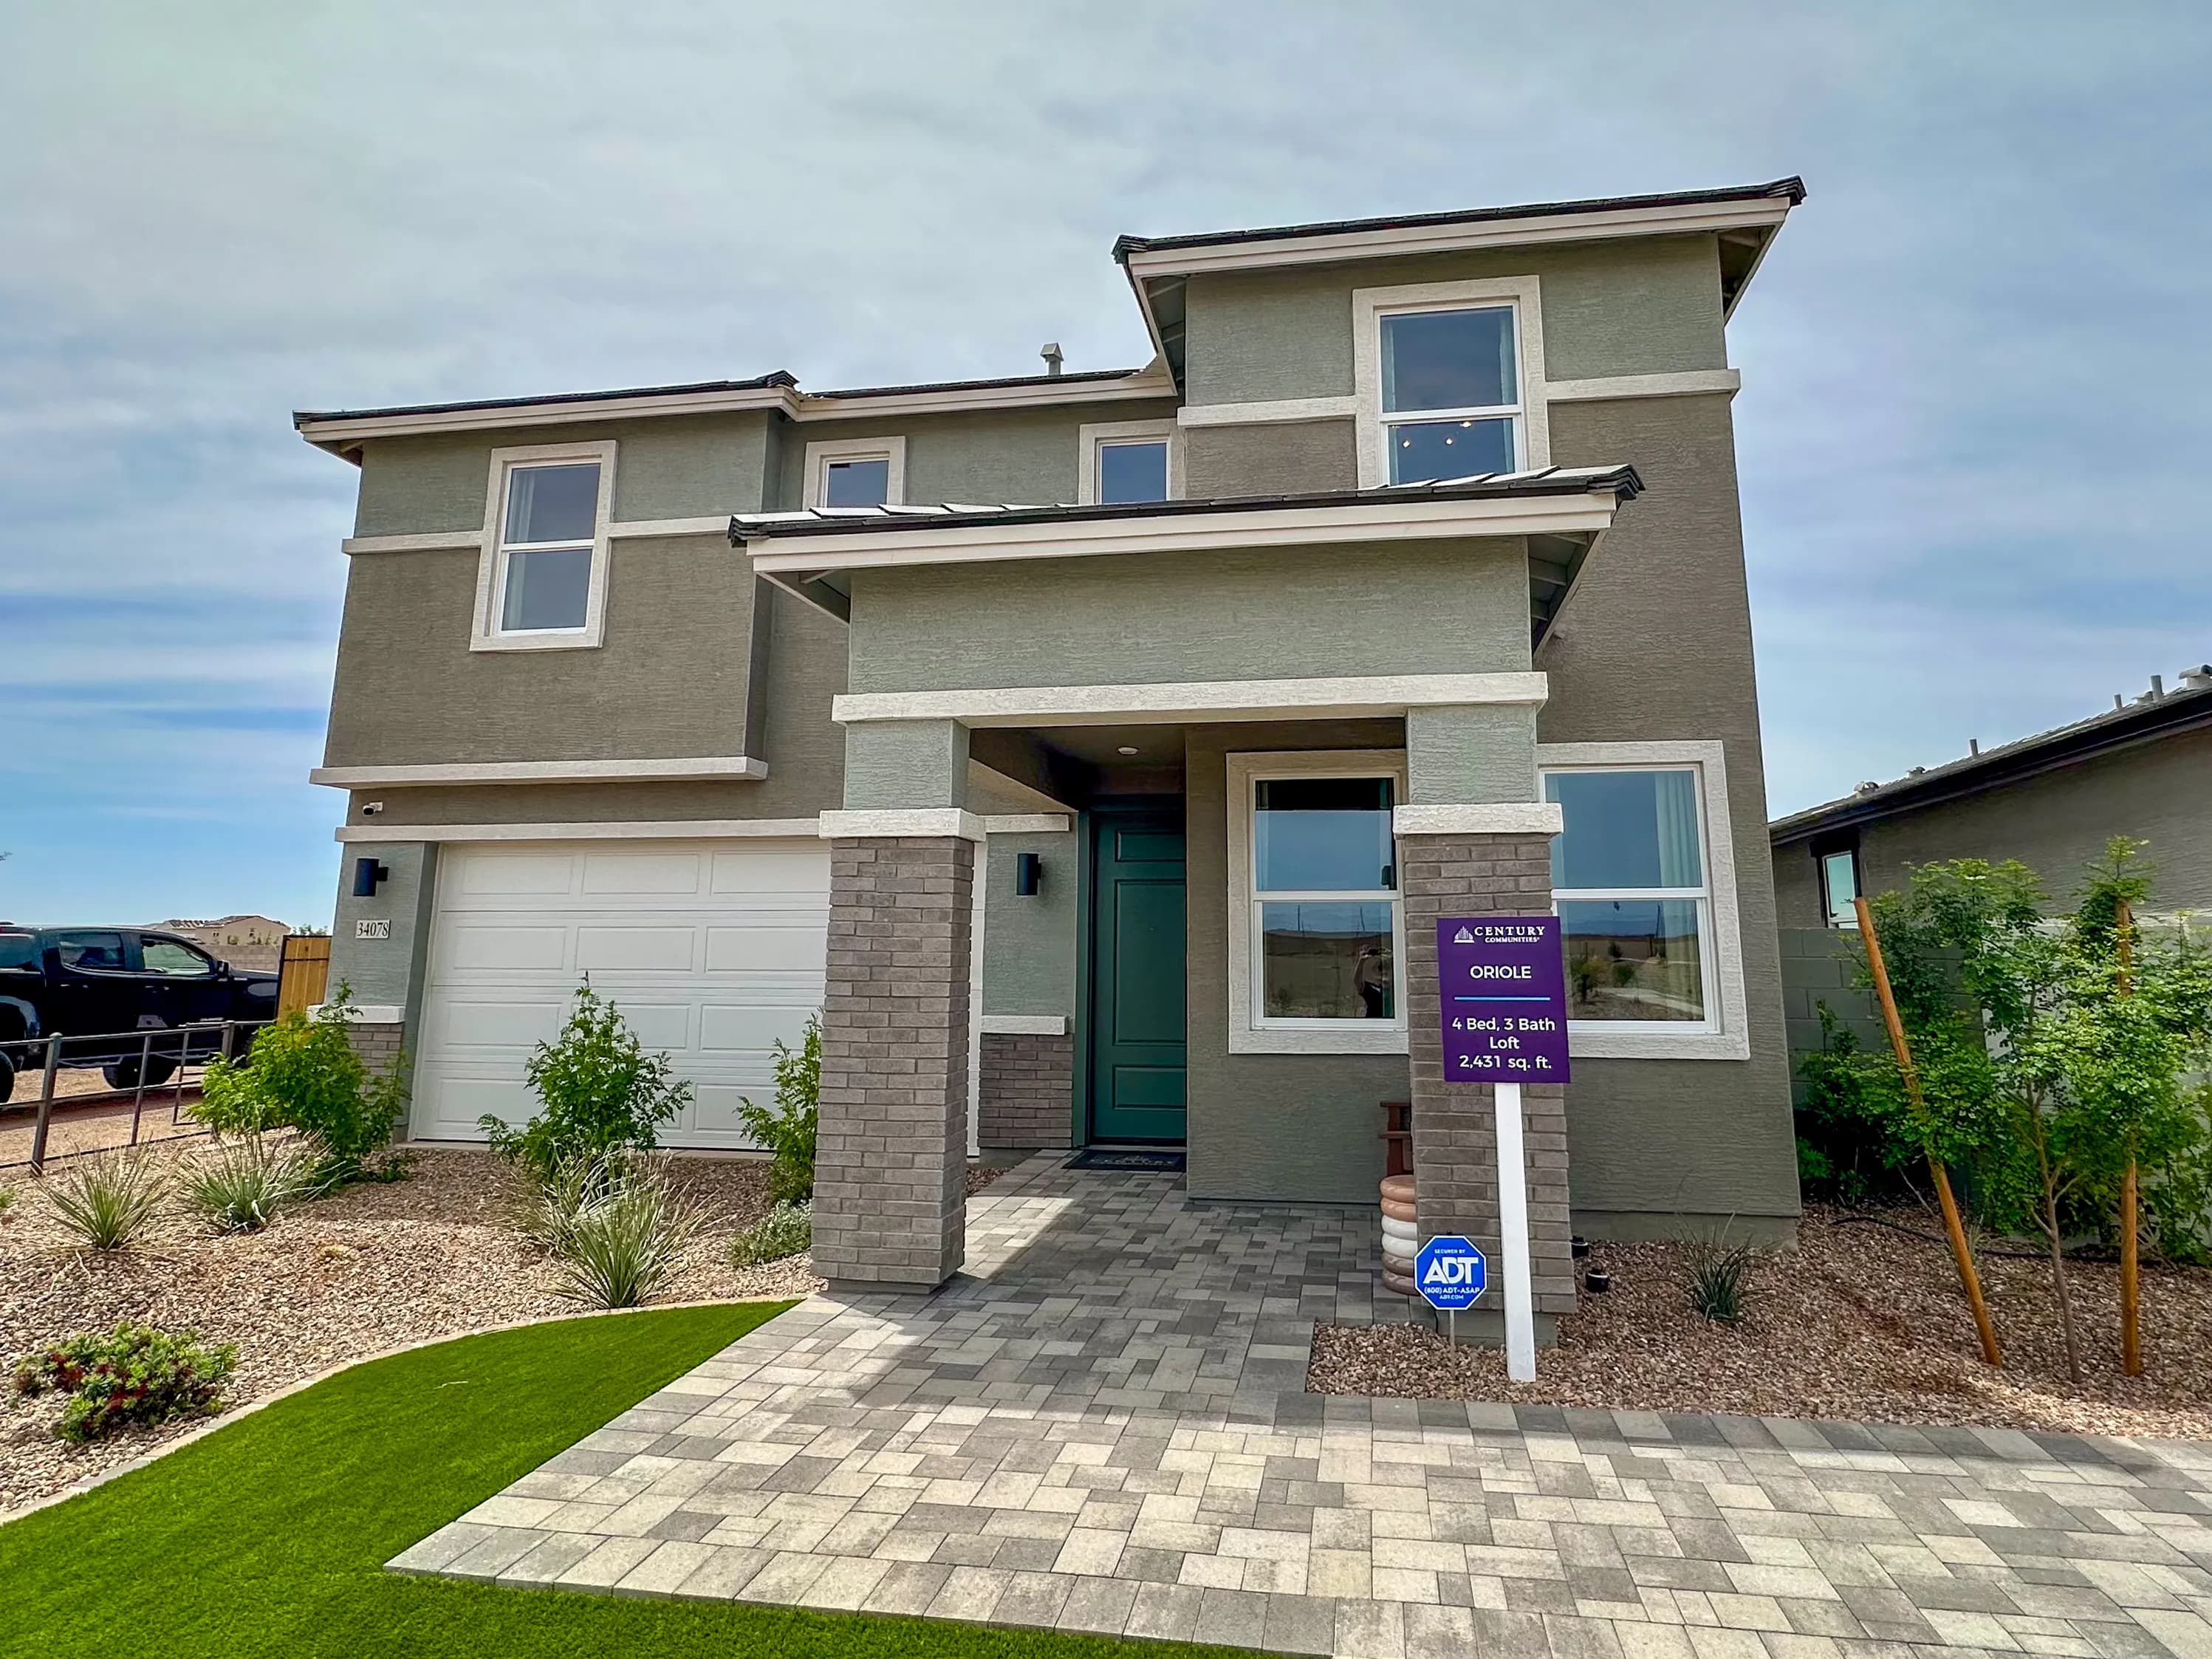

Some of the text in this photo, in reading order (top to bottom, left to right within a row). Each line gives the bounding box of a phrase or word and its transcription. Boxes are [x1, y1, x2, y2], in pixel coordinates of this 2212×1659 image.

[357, 922, 388, 937] 34078
[1474, 926, 1545, 936] CENTURY
[1470, 965, 1532, 979] ORIOLE
[1452, 1017, 1555, 1031] 4 Bed, 3 Bath
[1490, 1036, 1520, 1049] Loft
[1459, 1056, 1552, 1071] 2,431 sq. ft.
[1422, 1256, 1479, 1284] ADT
